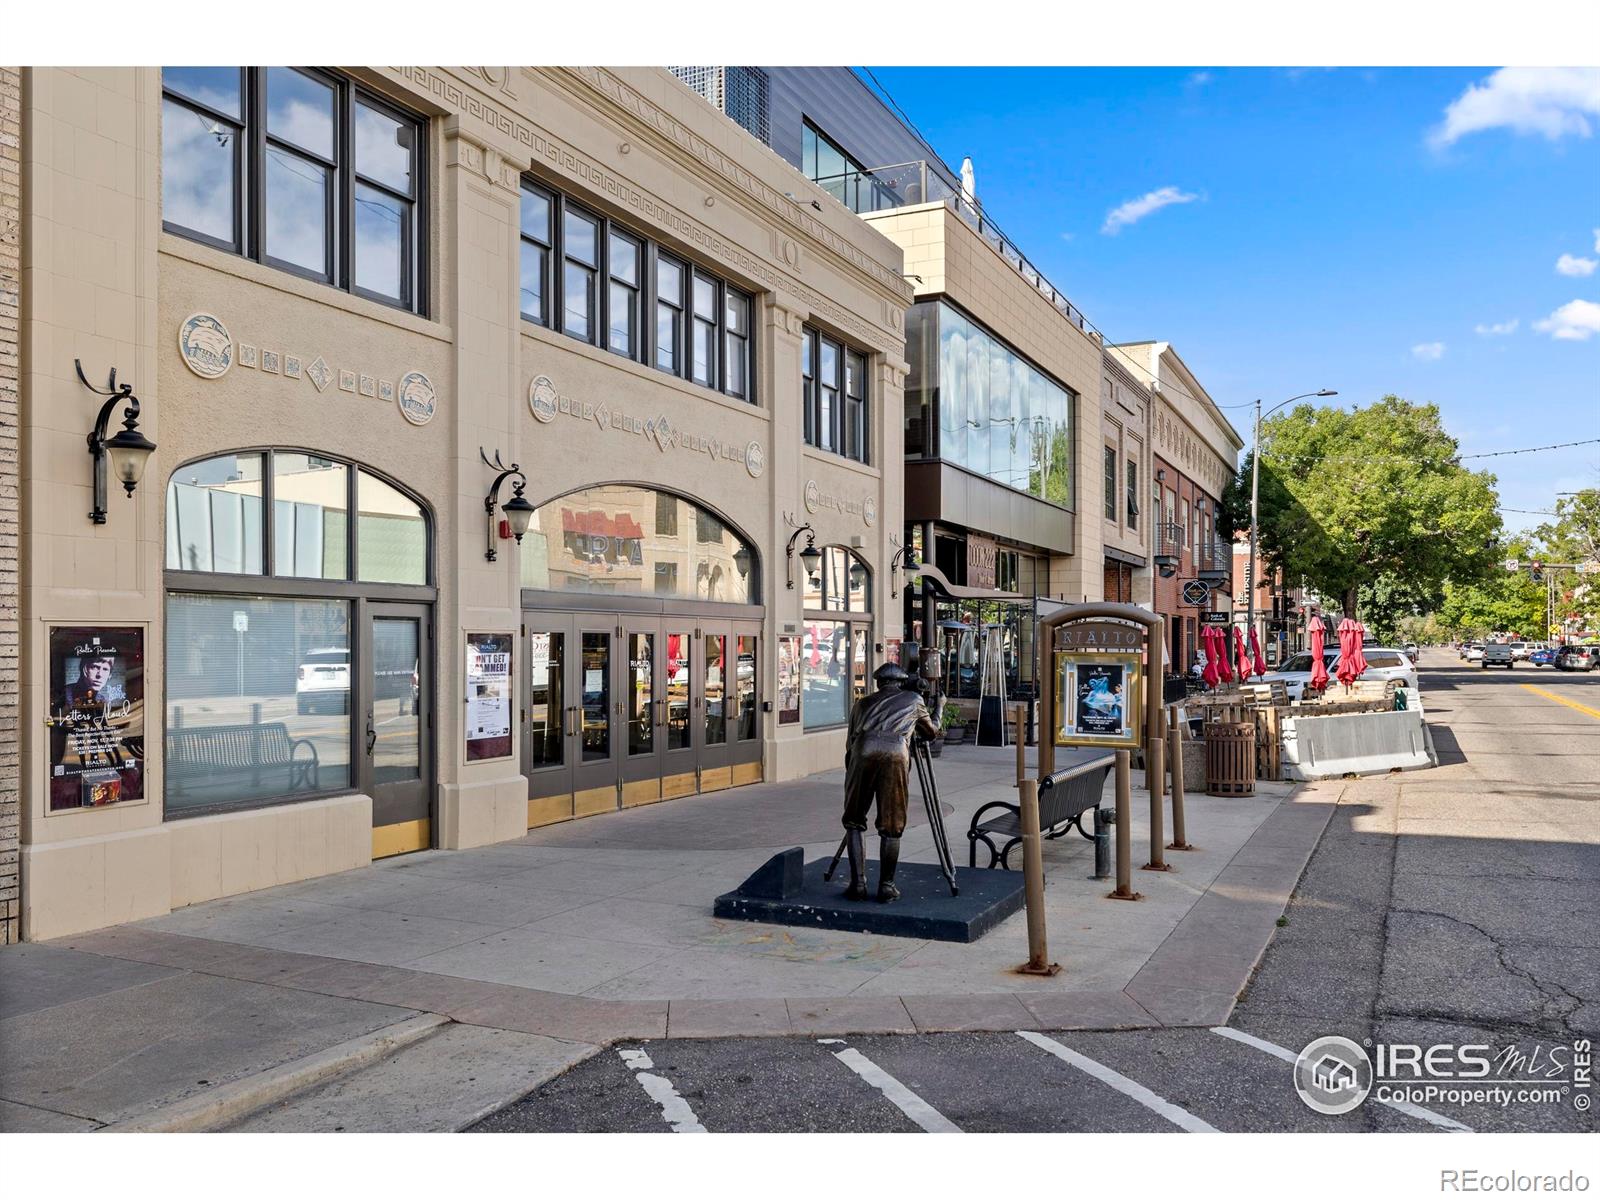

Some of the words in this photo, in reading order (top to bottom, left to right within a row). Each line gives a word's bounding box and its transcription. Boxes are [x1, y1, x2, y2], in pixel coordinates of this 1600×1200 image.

[1062, 631, 1136, 645] RIALTO
[494, 654, 505, 663] GET
[59, 707, 91, 727] Letters
[93, 700, 131, 727] Aloud
